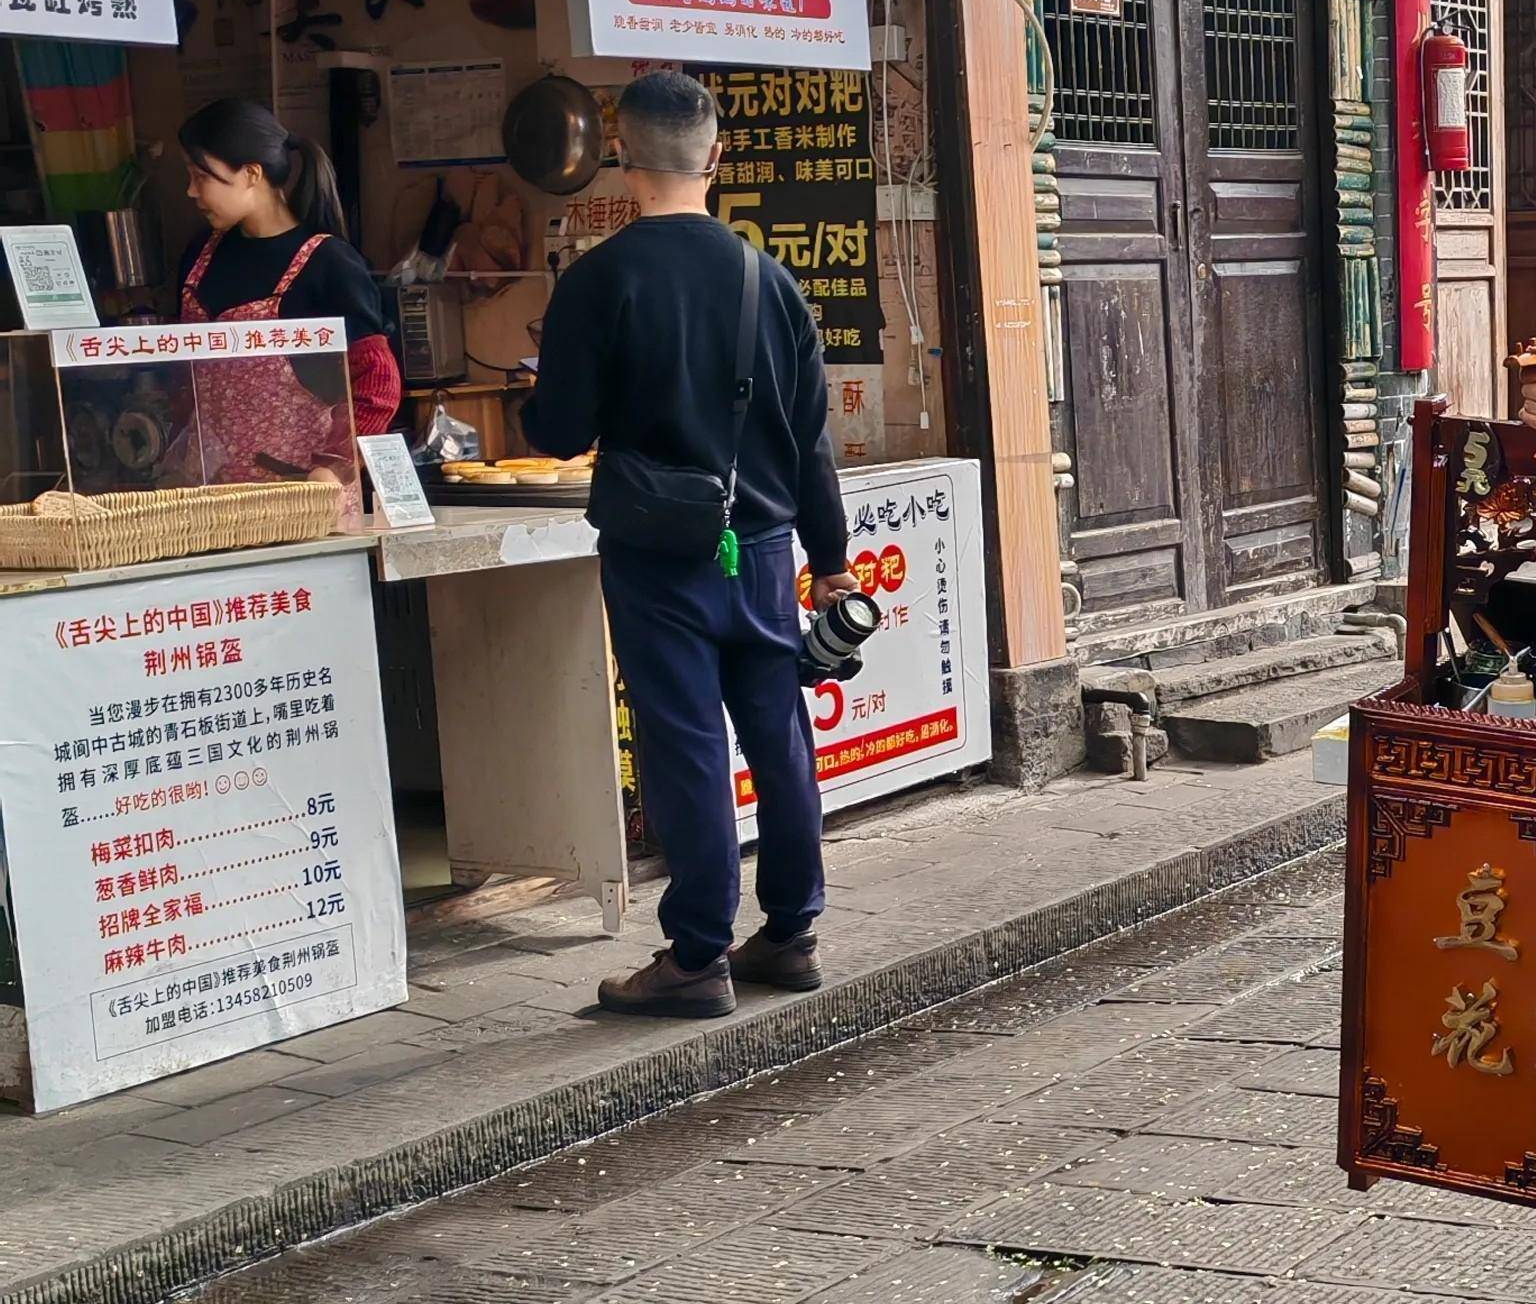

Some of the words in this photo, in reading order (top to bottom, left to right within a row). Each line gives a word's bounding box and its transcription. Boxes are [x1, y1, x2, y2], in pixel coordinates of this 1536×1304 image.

[711, 158, 873, 185] 香甜润、味美可口
[65, 327, 335, 361] 《舌尖上的中国》推荐美食
[53, 586, 312, 650] 《舌尖上的中国》推荐美食
[145, 637, 243, 677] 荆州锅盔
[89, 666, 332, 727] 当您漫步在拥有2300多年历史名
[91, 828, 175, 866] 梅菜扣肉
[307, 792, 336, 816] 8元
[95, 863, 178, 902] 葱香鲜肉
[310, 826, 339, 849] 9元
[98, 893, 204, 939] 招牌全家福
[302, 860, 342, 886] 10元
[104, 934, 186, 975] 麻辣牛肉
[306, 893, 345, 919] 12元
[108, 939, 340, 1018] 《舌尖上的中国》推荐美食荆州锅盔
[1434, 862, 1519, 1076] 豆花
